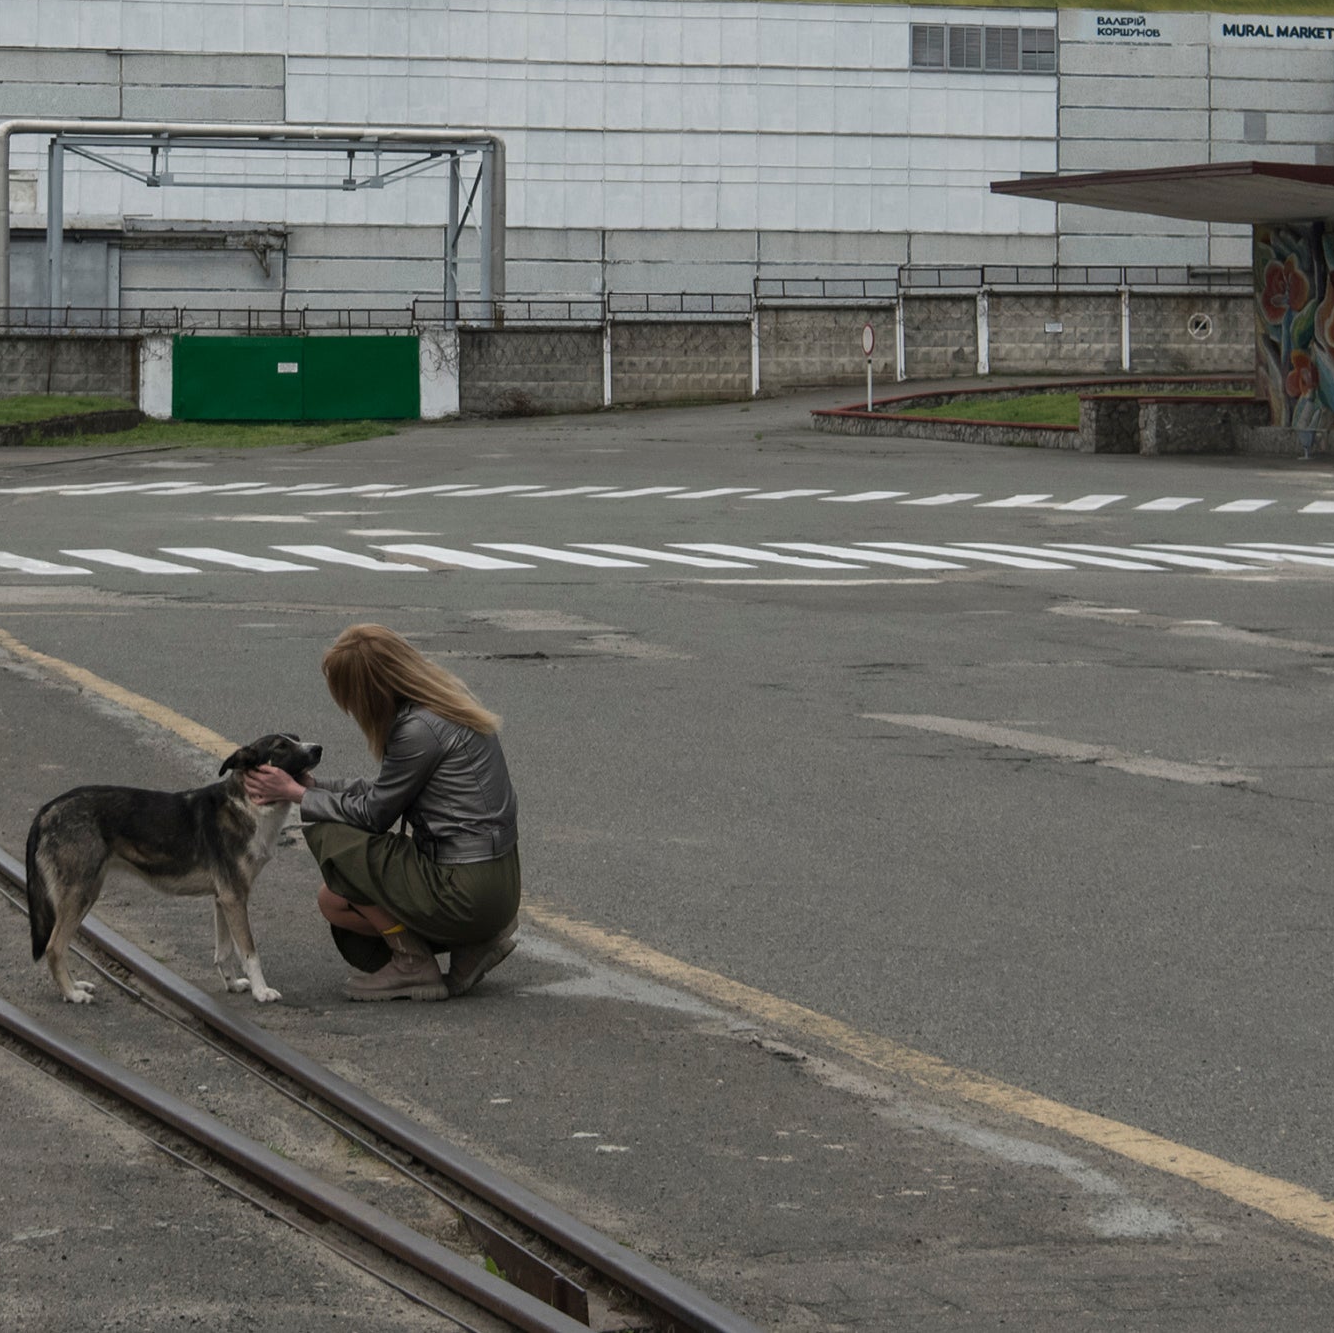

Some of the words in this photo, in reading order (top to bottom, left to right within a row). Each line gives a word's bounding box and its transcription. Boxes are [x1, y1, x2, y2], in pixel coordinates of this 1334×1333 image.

[1097, 16, 1146, 26] ВАЛЕРІЙ
[1097, 27, 1161, 38] КОРШУНОВ
[1223, 24, 1274, 38] MURAL
